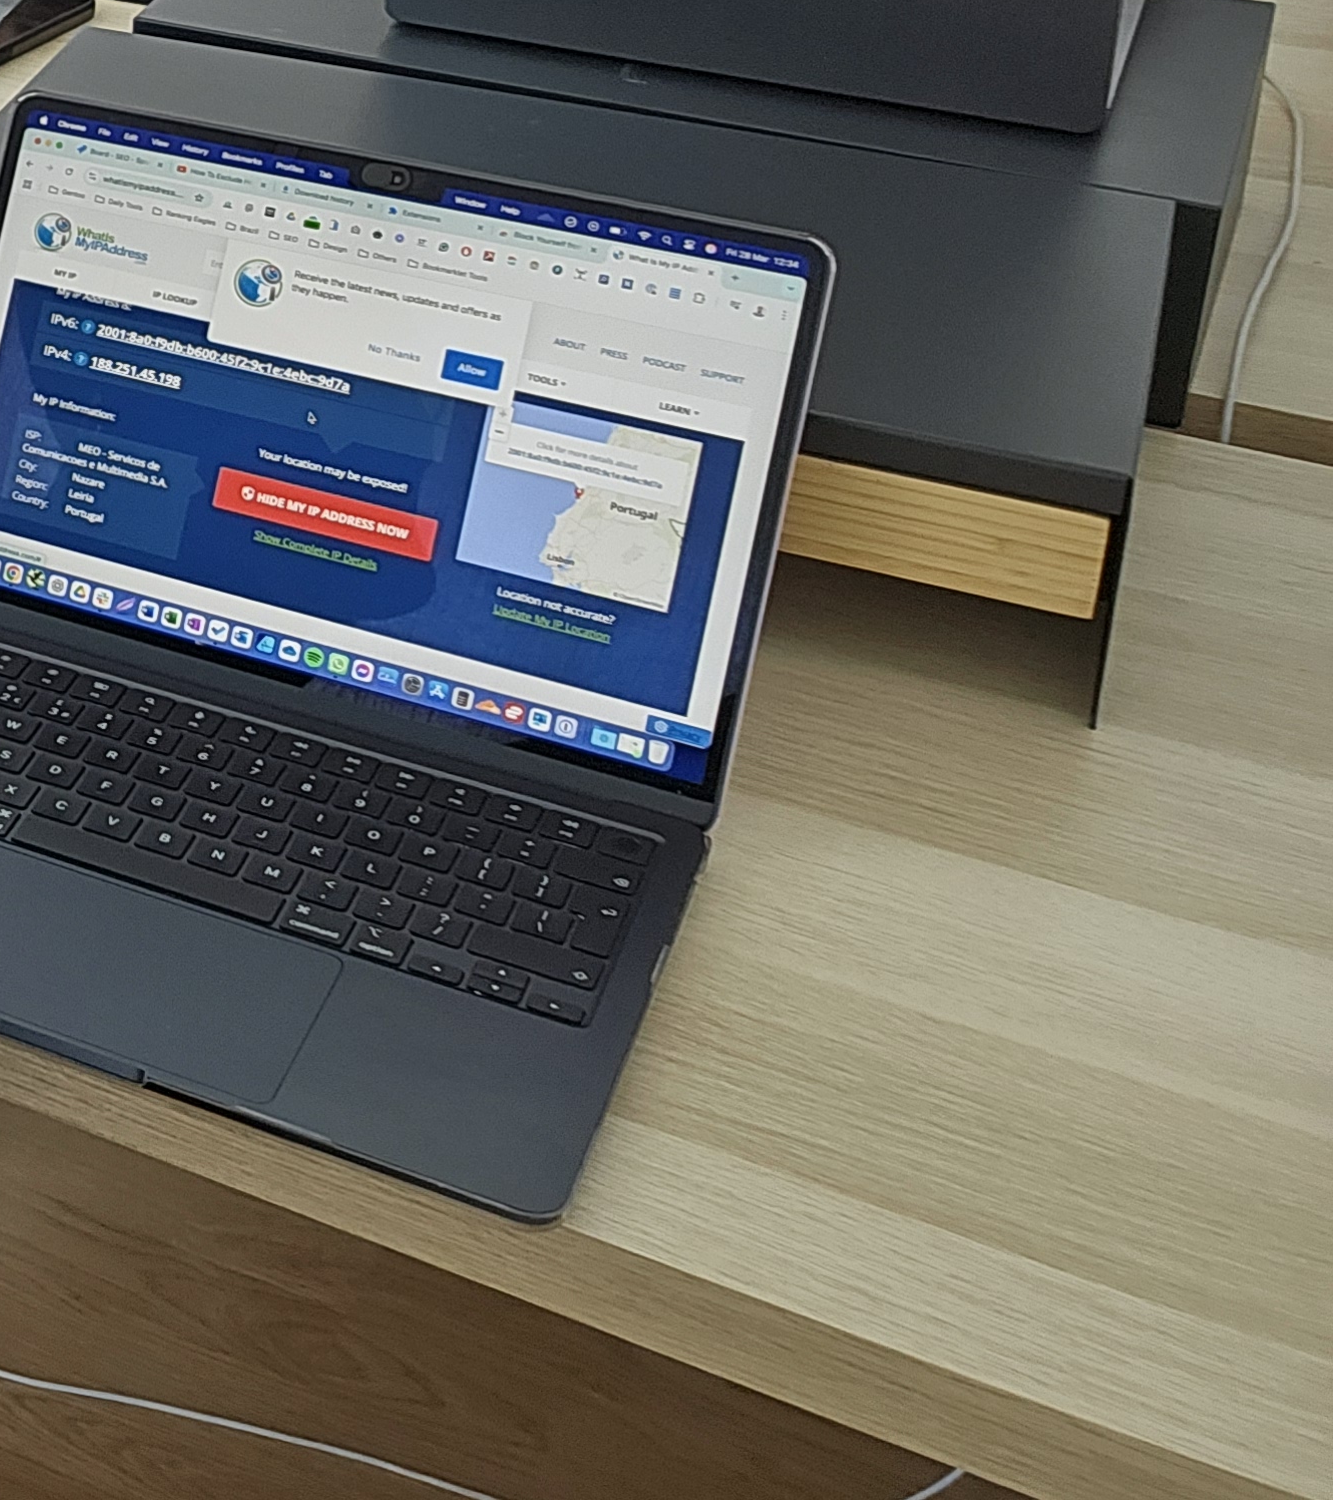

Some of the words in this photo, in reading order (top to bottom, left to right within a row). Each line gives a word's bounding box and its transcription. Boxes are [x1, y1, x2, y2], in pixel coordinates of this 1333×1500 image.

[56, 119, 88, 133] Chrome
[97, 127, 112, 137] File
[122, 132, 139, 142] Edit
[150, 137, 170, 148] View
[180, 143, 210, 157] History
[220, 150, 264, 166] Bookmarks
[274, 161, 305, 175] Profiles
[317, 169, 334, 180] Tab
[453, 195, 487, 209] Window
[499, 204, 521, 217] Help
[73, 235, 149, 263] MyIPAddress
[53, 268, 67, 278] MY
[67, 271, 77, 280] IP
[151, 290, 162, 299] IP
[161, 292, 198, 307] LOOKUP
[290, 283, 311, 296] they
[311, 287, 350, 304] happen.
[293, 270, 329, 285] Receive
[329, 277, 346, 289] the
[346, 281, 373, 294] latest
[372, 287, 401, 301] news,
[400, 292, 440, 310] updates
[439, 300, 460, 313] and
[459, 304, 489, 319] offers
[489, 312, 502, 321] as
[49, 312, 80, 330] IPv6:
[42, 344, 73, 362] IPv4:
[88, 355, 183, 390] 188.251.45.198
[366, 342, 383, 354] No
[383, 346, 421, 363] Thanks
[552, 336, 587, 352] ABOUT
[598, 346, 628, 360] PRESS
[642, 355, 686, 373] PODCAST
[699, 367, 745, 385] SUPPORT
[456, 362, 487, 377] Allow
[525, 372, 559, 387] TOOLS
[31, 392, 48, 407] My
[47, 396, 59, 408] IP
[57, 398, 117, 422] Information:
[657, 401, 691, 416] LEARN
[20, 442, 88, 468] Comunicacoes
[87, 460, 96, 470] e
[96, 460, 149, 483] Multimedia
[24, 429, 43, 442] ISP:
[77, 442, 102, 457] MEO
[106, 449, 147, 468] Servicos
[146, 459, 161, 471] de
[17, 459, 39, 474] City:
[70, 472, 106, 489] Nazare
[257, 448, 283, 463] Your
[282, 454, 323, 473] location
[322, 465, 346, 481] may
[346, 469, 362, 482] be
[360, 473, 408, 495] exposed!
[14, 474, 49, 493] Region:
[66, 487, 95, 503] Leiria
[10, 490, 50, 511] Country:
[63, 504, 105, 526] Portugal
[255, 491, 287, 509] HIDE
[285, 498, 307, 514] MY
[306, 504, 321, 518] IP
[319, 507, 376, 532] ADDRESS
[375, 521, 410, 540] NOW
[608, 500, 659, 523] Portugal
[252, 529, 282, 547] Show
[281, 536, 331, 560] Complete
[330, 549, 342, 562] IP
[342, 552, 379, 572] Details
[545, 552, 576, 567] Lisbon
[495, 585, 542, 607] Location
[541, 598, 563, 613] not
[562, 603, 617, 626] accurate?
[491, 602, 534, 624] Update
[532, 613, 551, 629] My
[550, 618, 563, 632] IP
[563, 621, 613, 644] Location
[5, 718, 22, 730] W
[55, 734, 68, 745] E
[104, 749, 119, 760] R
[158, 764, 170, 774] T
[209, 780, 221, 790] Y
[259, 796, 274, 807] U
[315, 812, 324, 822] I
[366, 829, 381, 840] O
[422, 845, 436, 855] P
[3, 783, 18, 795] X
[54, 799, 69, 810] C
[107, 814, 120, 826] V
[157, 832, 172, 843] B
[210, 848, 226, 860] N
[263, 865, 281, 878] M
[48, 764, 62, 774] D
[99, 780, 112, 789] F
[149, 795, 164, 806] G
[201, 811, 217, 823] H
[255, 829, 268, 839] J
[309, 845, 324, 857] K
[365, 862, 376, 874] L
[286, 917, 340, 940] command
